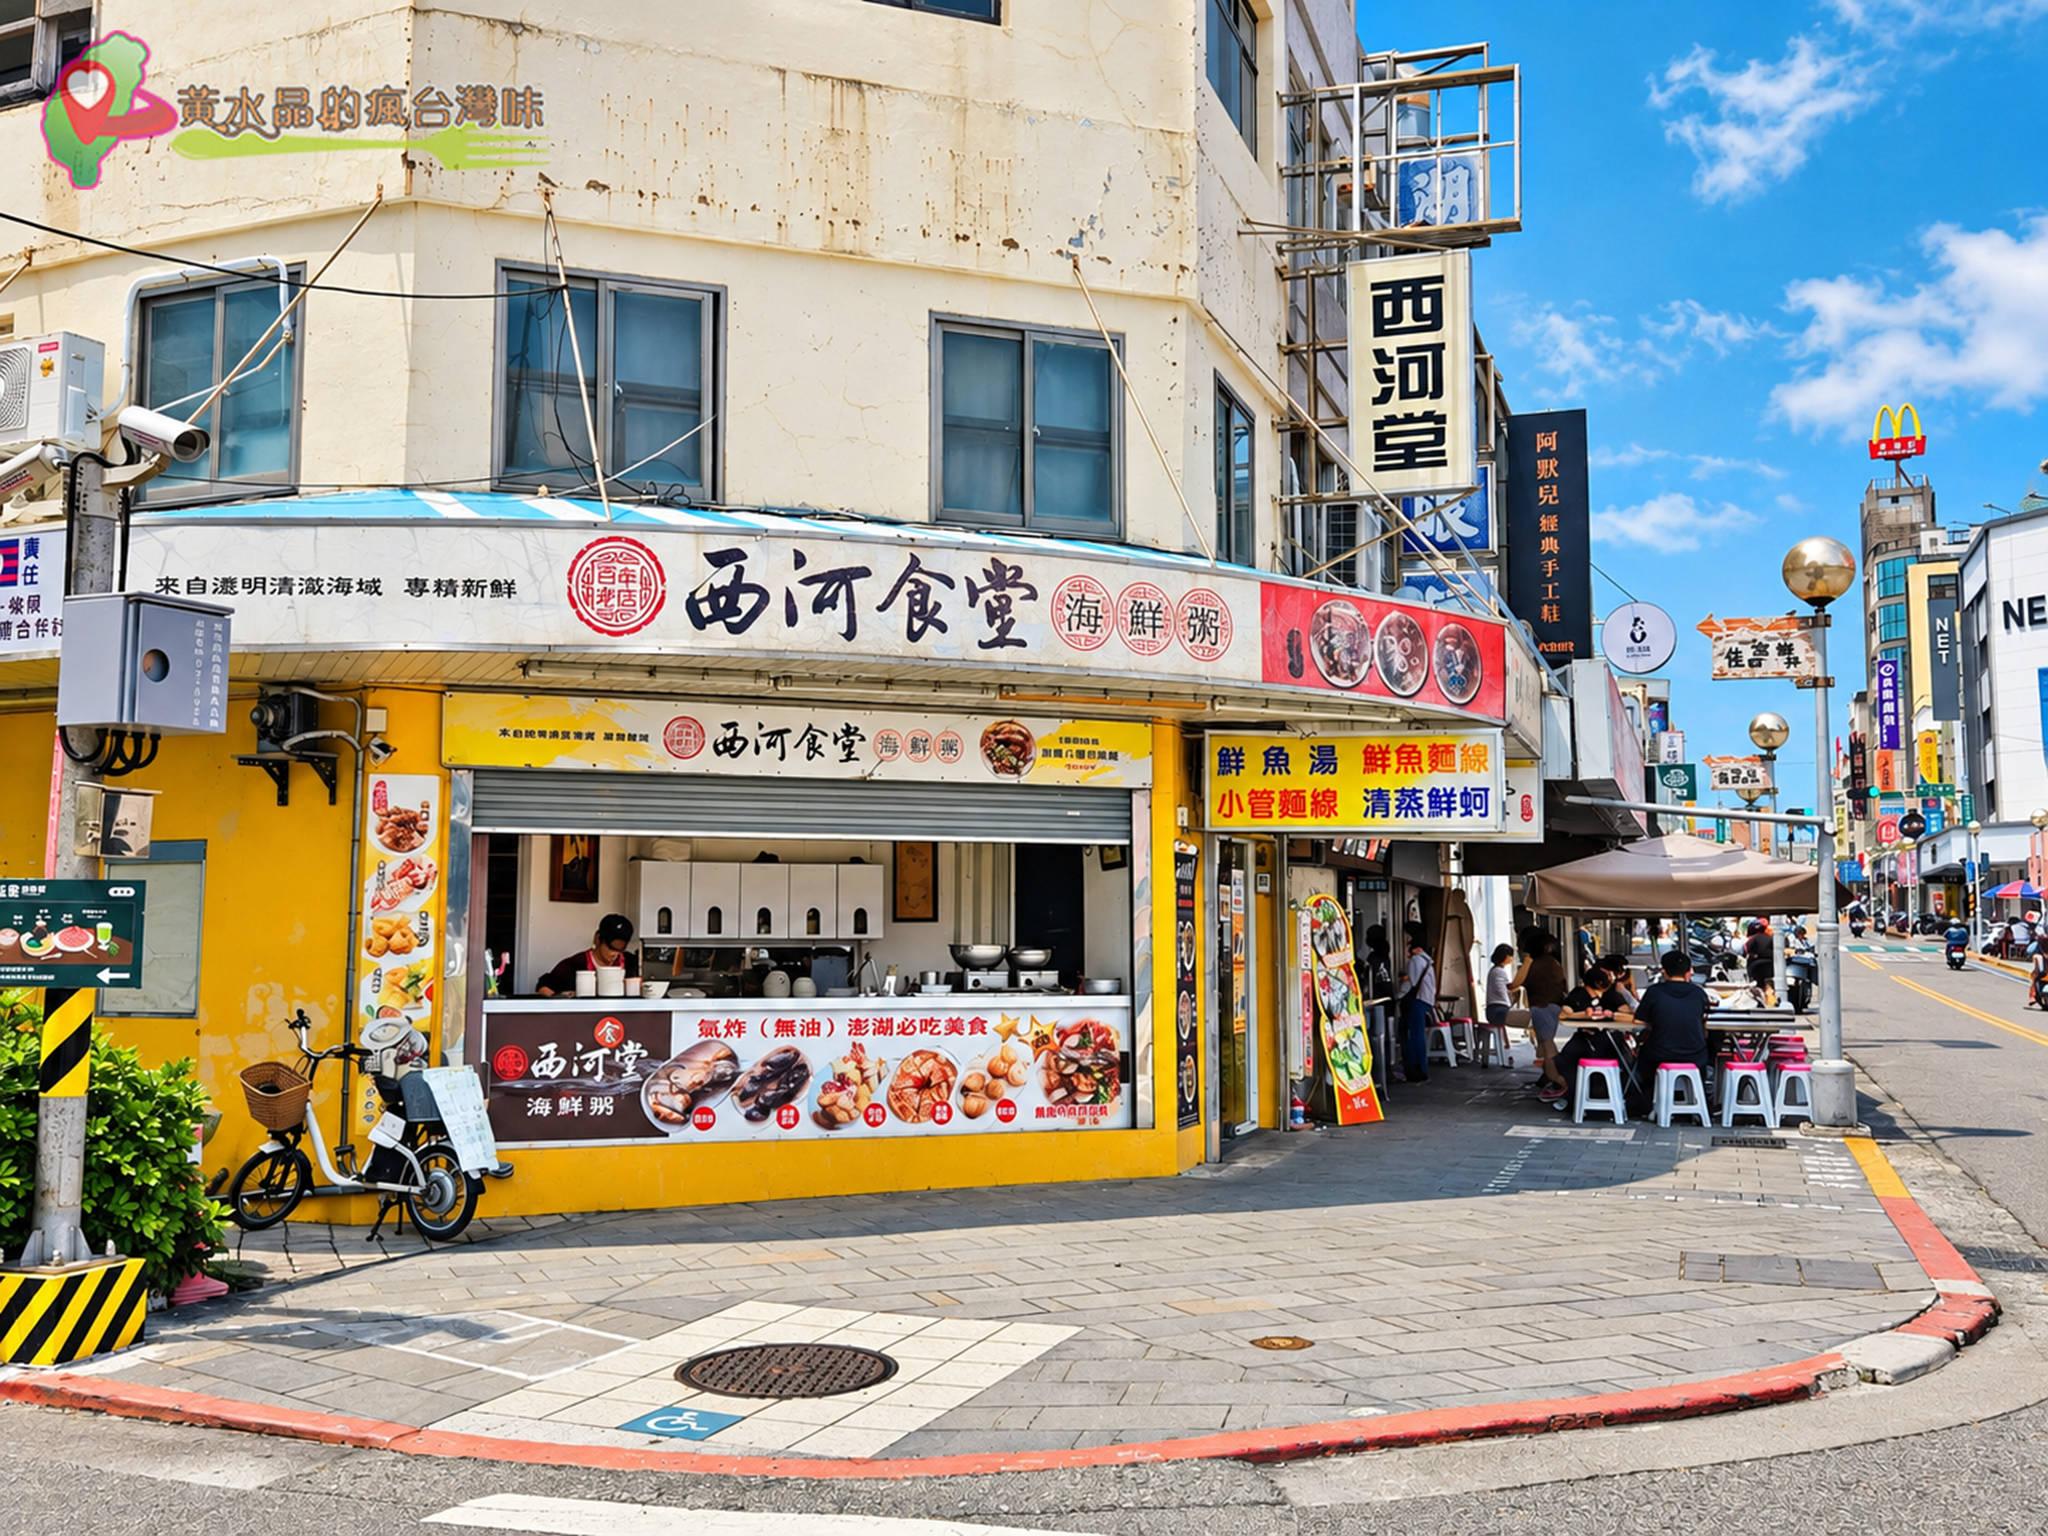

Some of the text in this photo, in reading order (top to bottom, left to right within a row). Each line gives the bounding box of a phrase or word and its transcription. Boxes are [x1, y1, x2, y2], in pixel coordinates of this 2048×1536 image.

[1371, 275, 1447, 472] 西河堂
[404, 577, 517, 598] 專精新鮮
[686, 548, 1038, 649] 西河食堂
[1066, 593, 1219, 646] 海鮮粥
[1936, 617, 1949, 664] NET
[712, 722, 866, 763] 西河食堂
[1217, 743, 1489, 776] 鮮魚湯 鮮魚麵線
[1217, 788, 1338, 819] 小管麵線
[1363, 786, 1490, 819] 清蒸鮮蚵
[530, 1040, 649, 1082] 西河堂
[526, 1096, 614, 1117] 海鮮粥
